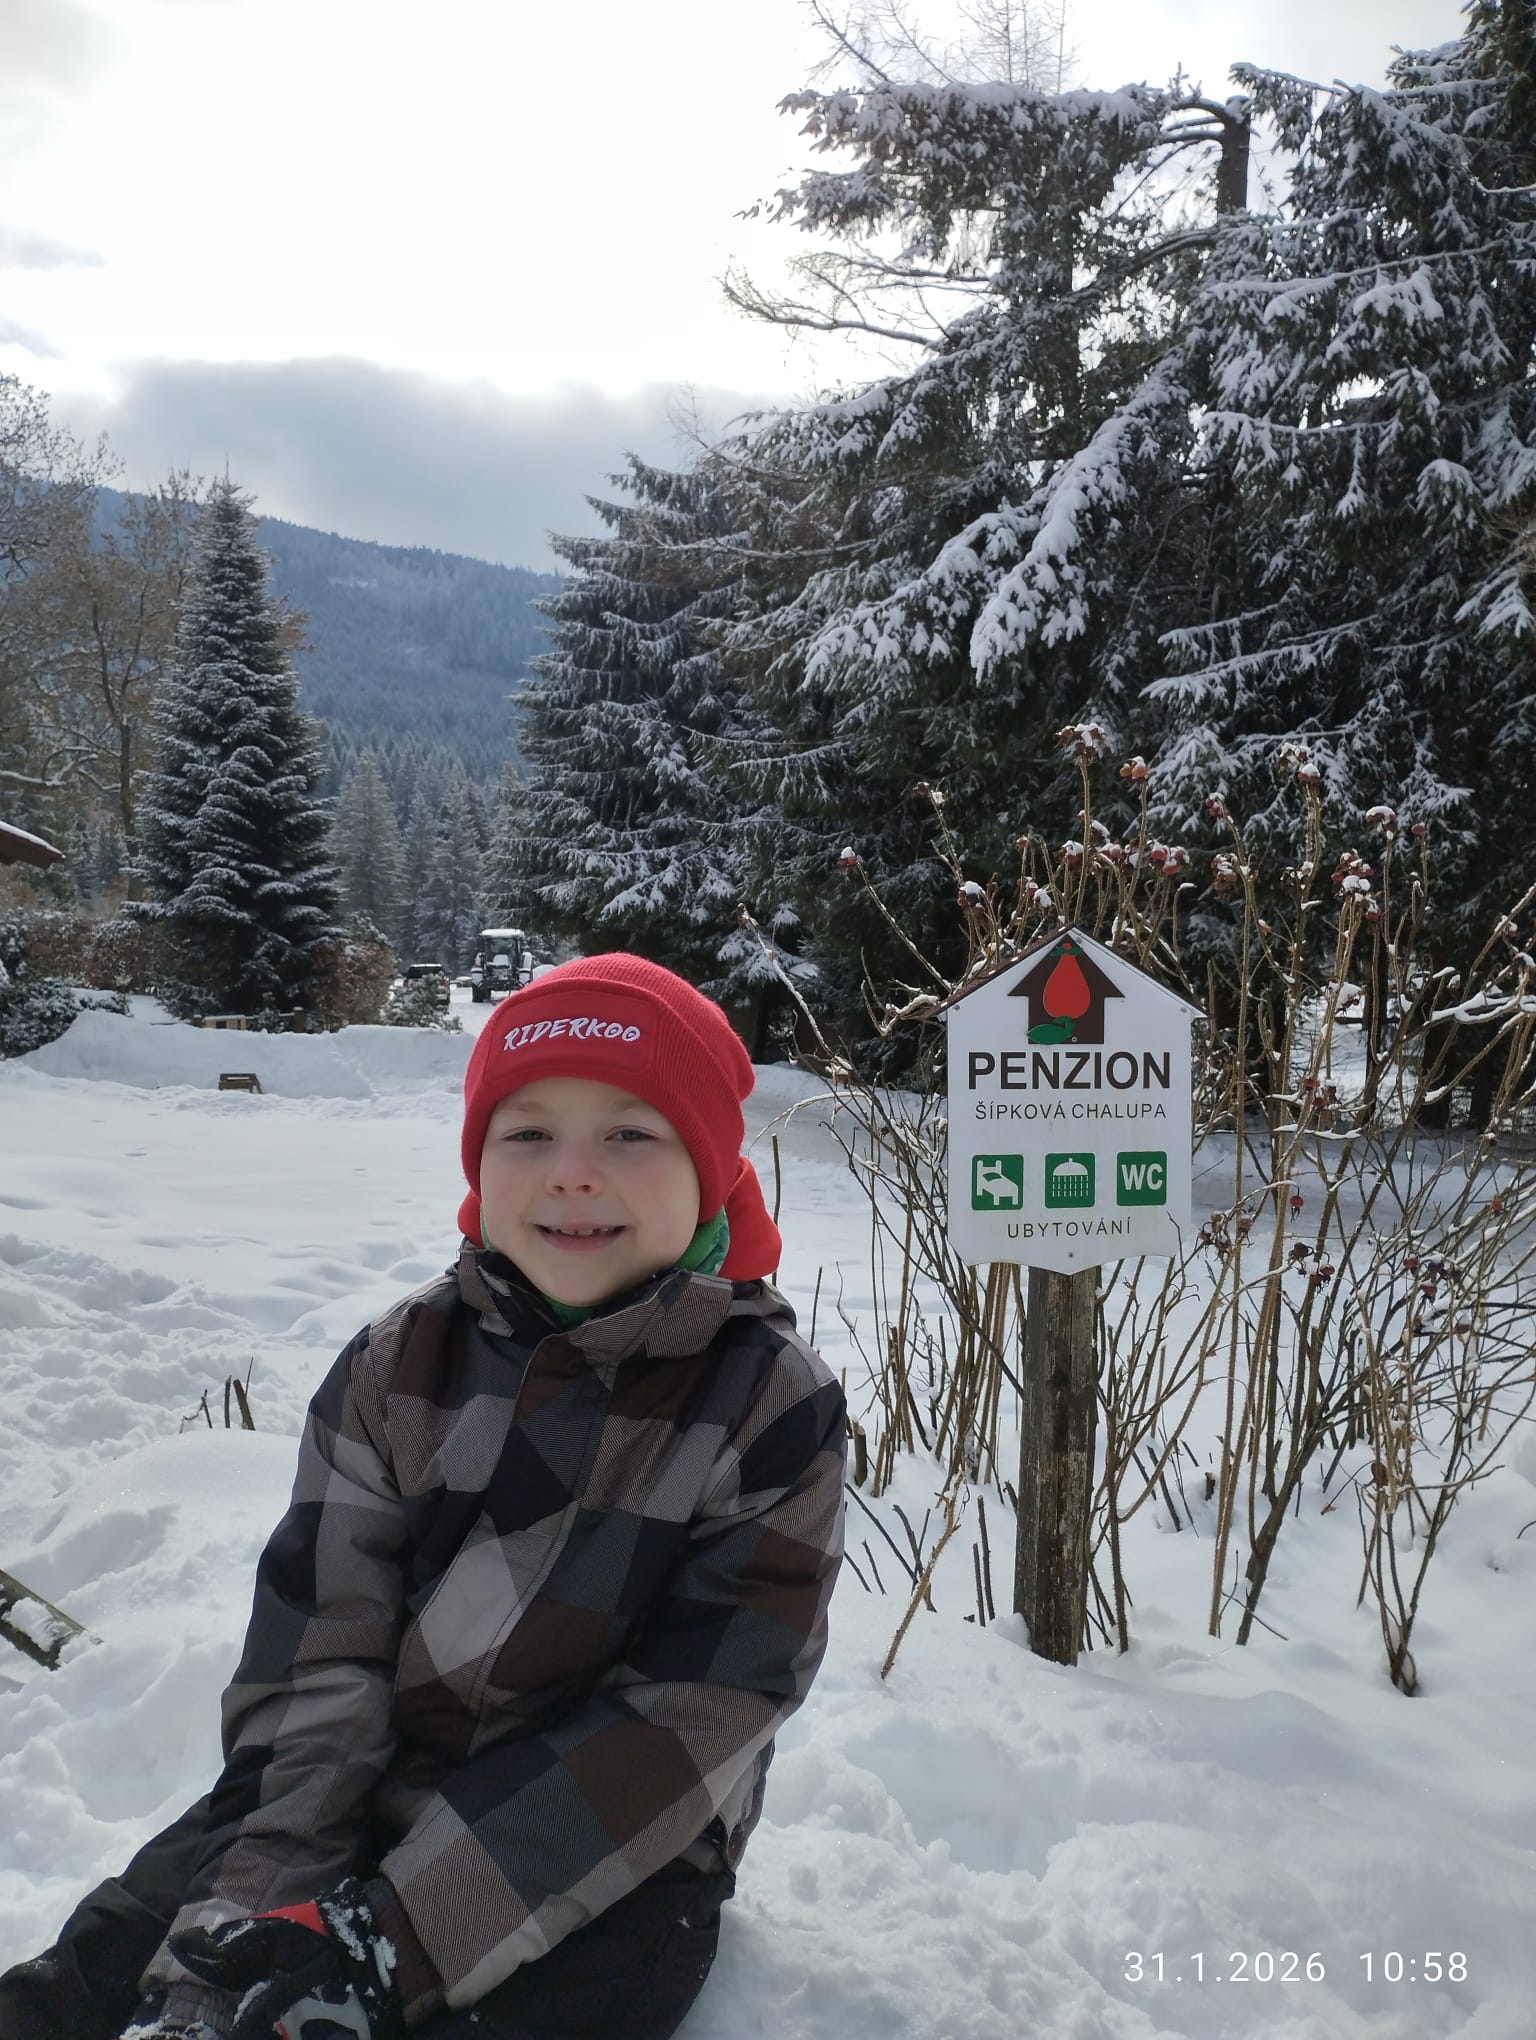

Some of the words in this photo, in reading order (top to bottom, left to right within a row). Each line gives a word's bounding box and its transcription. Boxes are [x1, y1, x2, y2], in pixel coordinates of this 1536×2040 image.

[503, 1017, 641, 1052] RIDERKOO
[968, 1051, 1171, 1090] PENZION
[975, 1100, 1066, 1120] ŠÍPKOVÁ
[1071, 1103, 1167, 1119] CHALUPA
[1121, 1163, 1163, 1191] WC
[1007, 1216, 1131, 1239] UBYTOVÁNÍ
